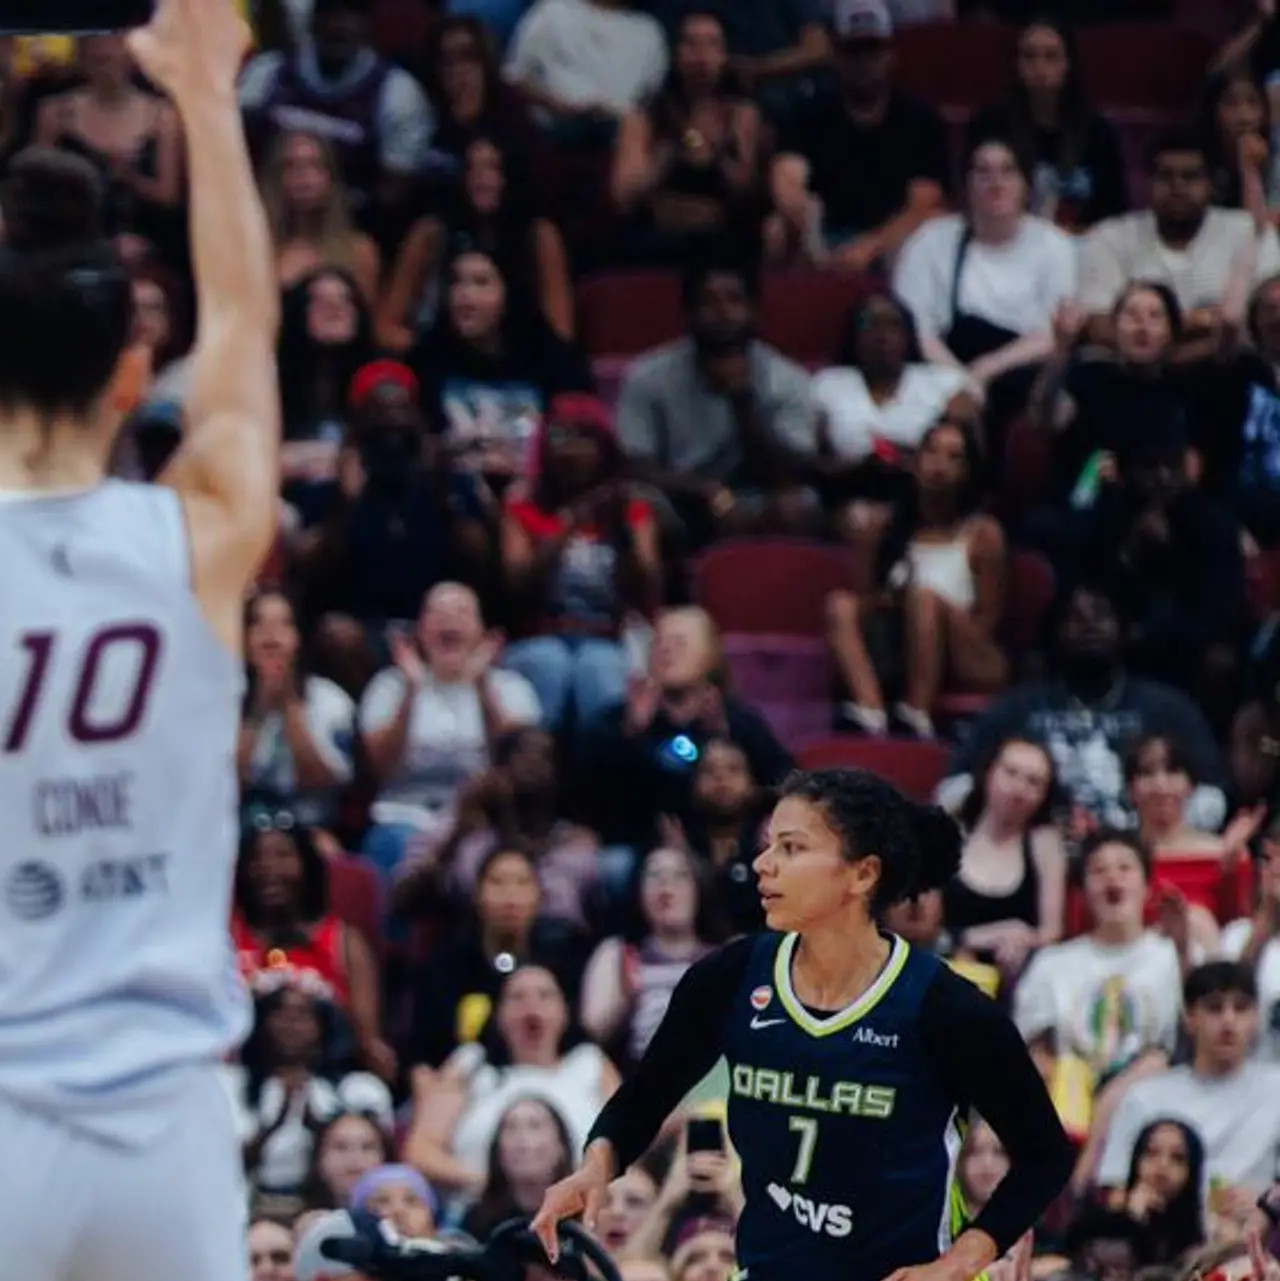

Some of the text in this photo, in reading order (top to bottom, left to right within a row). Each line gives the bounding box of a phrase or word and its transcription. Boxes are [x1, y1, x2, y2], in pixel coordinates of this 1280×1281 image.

[1, 624, 161, 752] 10
[852, 1026, 900, 1048] Albert
[733, 1063, 896, 1118] DALLAS
[789, 1115, 818, 1184] 7
[792, 1193, 853, 1237] CVS
